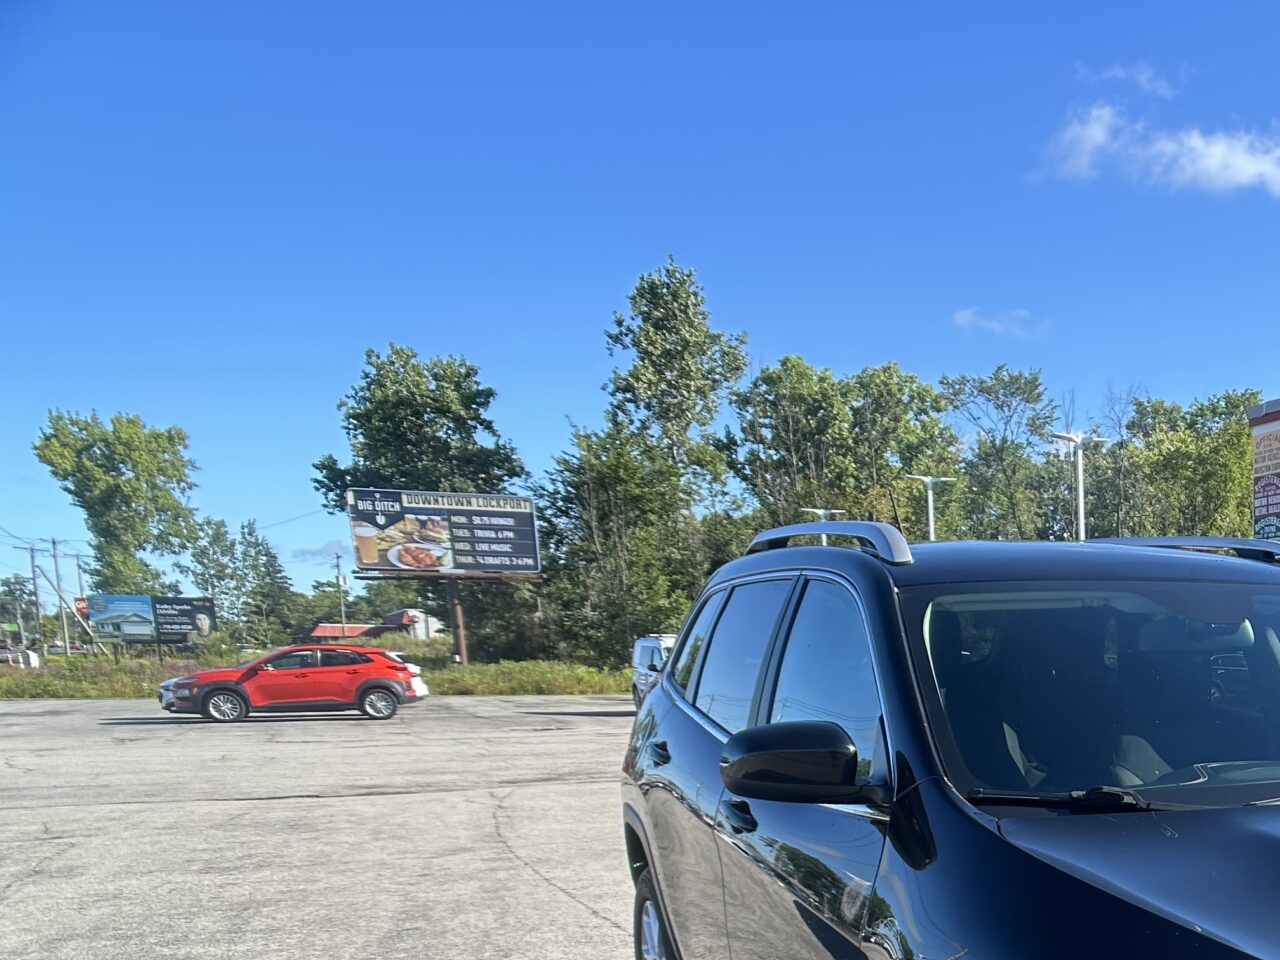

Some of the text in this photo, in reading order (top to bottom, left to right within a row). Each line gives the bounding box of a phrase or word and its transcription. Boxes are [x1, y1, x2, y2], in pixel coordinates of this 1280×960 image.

[357, 500, 400, 512] BIG DITCH
[405, 493, 529, 510] DOWNTOWN LOCKPORT
